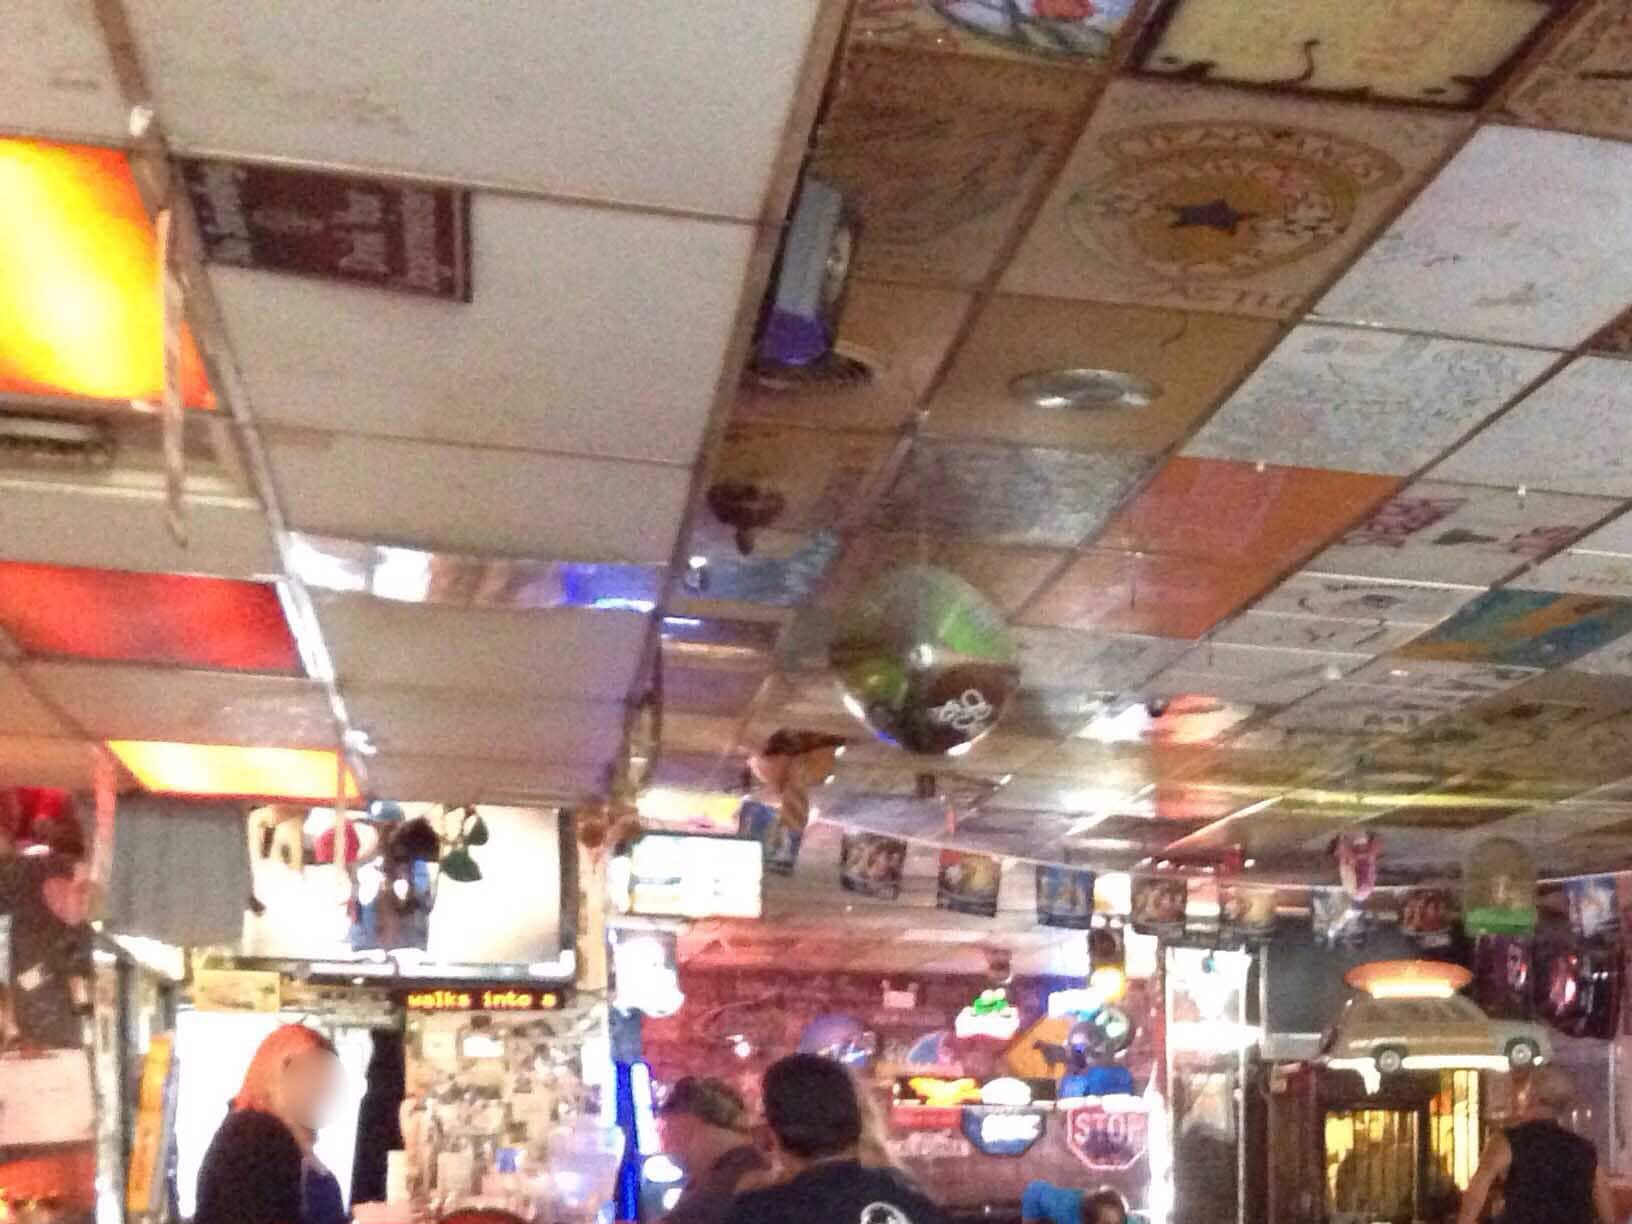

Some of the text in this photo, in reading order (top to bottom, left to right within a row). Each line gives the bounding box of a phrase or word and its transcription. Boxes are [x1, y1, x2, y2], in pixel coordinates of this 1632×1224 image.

[407, 990, 471, 1008] walks
[482, 990, 532, 1008] into
[1074, 1111, 1147, 1146] STOP
